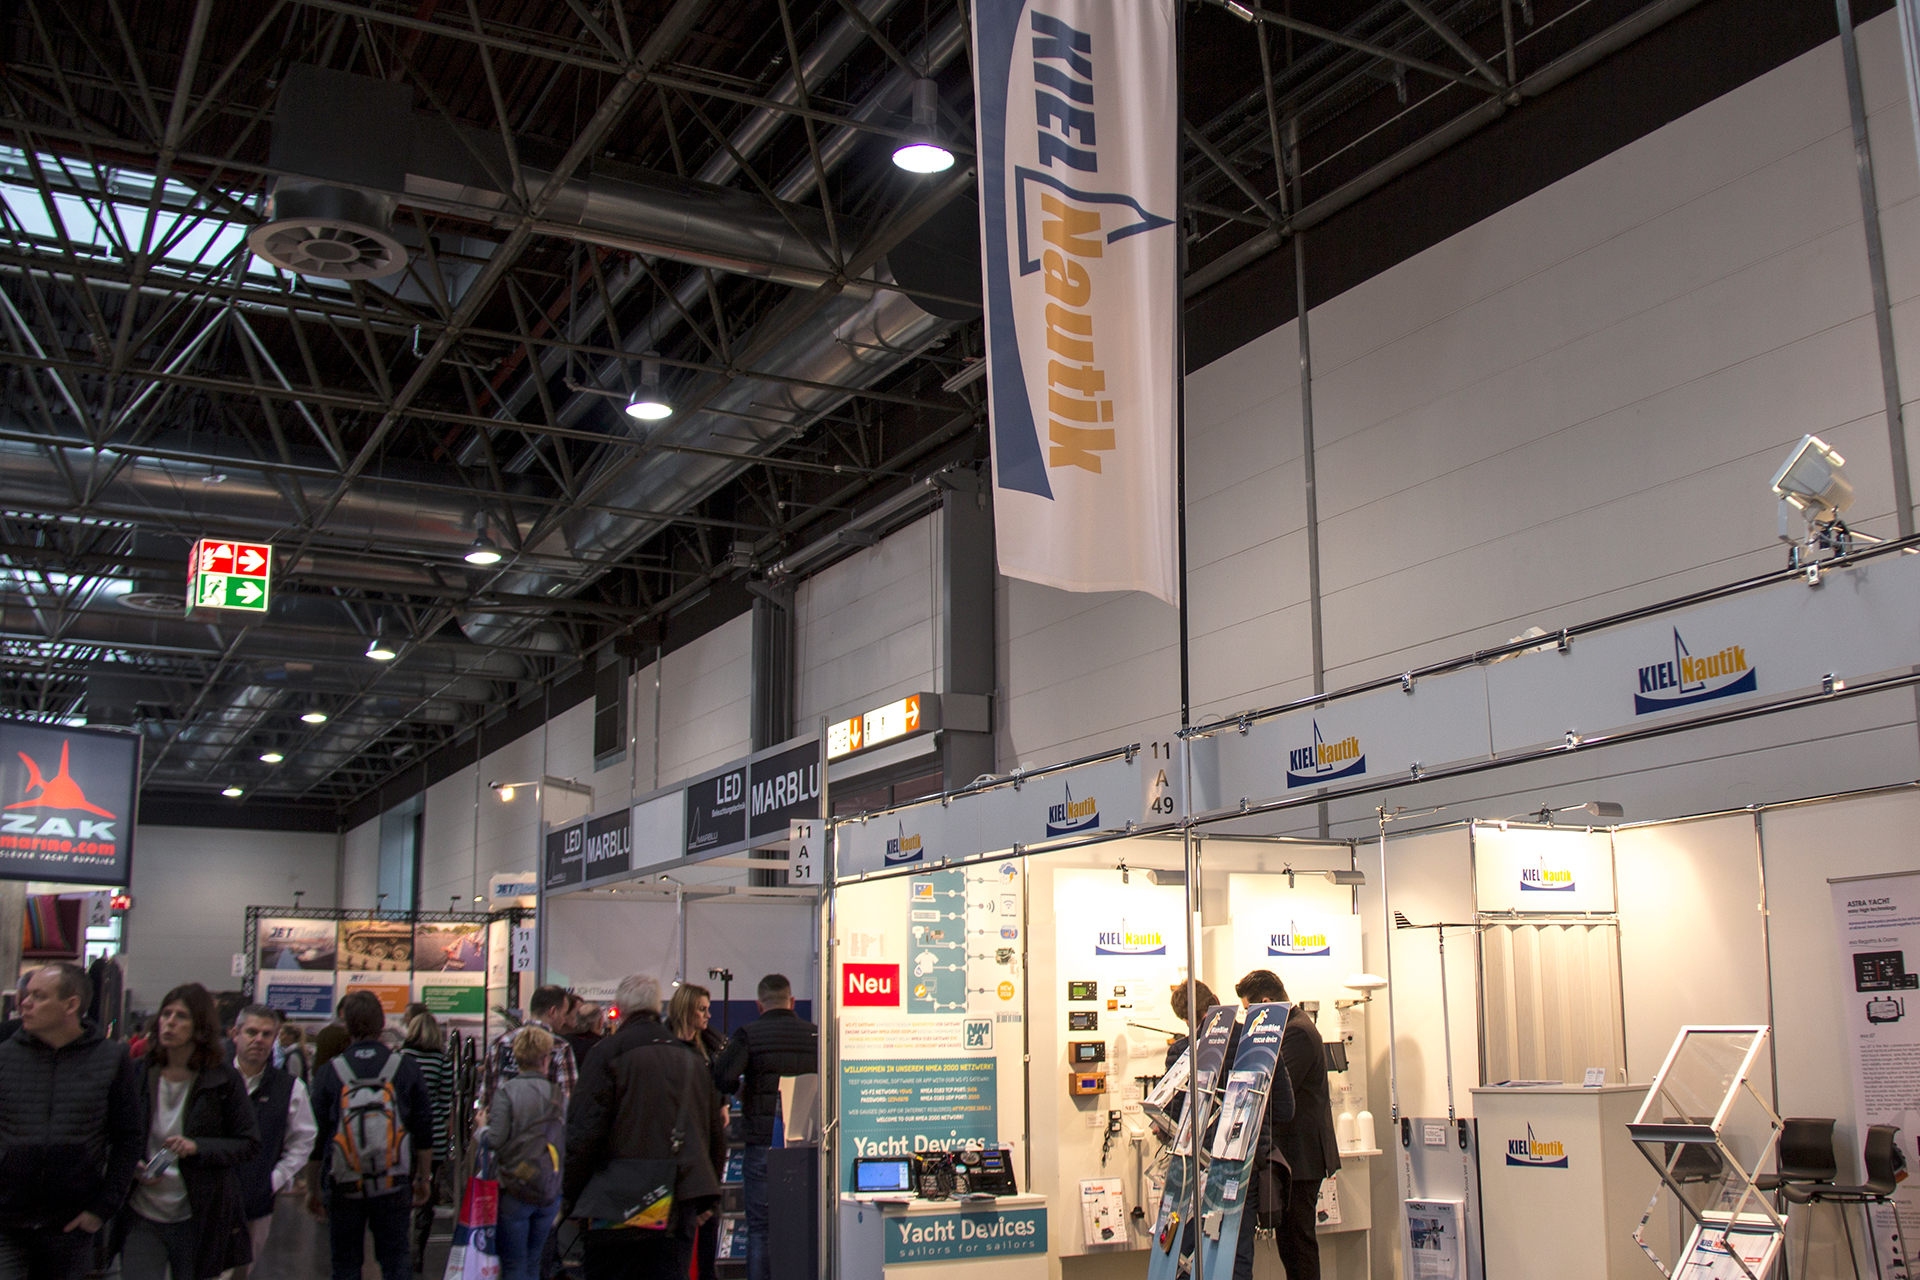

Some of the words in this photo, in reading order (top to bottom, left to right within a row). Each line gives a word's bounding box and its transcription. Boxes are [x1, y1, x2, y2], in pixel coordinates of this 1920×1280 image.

[1031, 9, 1098, 173] KIEL
[1041, 191, 1116, 475] Nautik
[1638, 661, 1678, 694] KIEL
[1681, 645, 1748, 684] Nautik
[1151, 742, 1170, 759] 11
[1290, 746, 1315, 772] KIEL
[1317, 736, 1360, 765] Nautik
[1155, 769, 1169, 787] A
[716, 773, 741, 805] LED
[751, 762, 820, 817] MARBLU
[1049, 803, 1066, 824] KIEL
[1067, 796, 1096, 819] Nautik
[1151, 796, 1174, 814] 49
[1, 813, 117, 841] ZAK
[797, 825, 811, 838] 11
[0, 835, 116, 856] marine.com
[564, 829, 581, 854] LED
[586, 826, 630, 864] MARBLU
[798, 845, 809, 858] A
[887, 838, 899, 855] KIEL
[900, 833, 921, 852] Nautik
[39, 853, 69, 862] YACHT
[72, 855, 116, 866] SUPPLIES
[795, 865, 811, 878] 51
[1522, 868, 1541, 881] KIEL
[1543, 869, 1572, 882] Nautik
[1868, 897, 1890, 905] YACHT
[518, 931, 530, 941] 11
[1099, 932, 1122, 945] KIEL
[1125, 932, 1162, 945] Nautik
[1270, 934, 1291, 946] KIEL
[1294, 933, 1327, 947] Nautik
[520, 945, 529, 954] A
[517, 958, 530, 968] 57
[848, 973, 891, 994] Neu
[967, 1023, 990, 1035] NM
[967, 1033, 984, 1046] EA
[844, 1065, 886, 1073] WILLKOMMEN
[886, 1065, 894, 1073] IN
[895, 1065, 924, 1073] UNSEREM
[925, 1064, 942, 1072] NMEA
[943, 1064, 959, 1072] 2000
[960, 1063, 994, 1071] NETZWERK!
[853, 1135, 909, 1157] Yacht
[914, 1130, 985, 1153] Devices
[1508, 1139, 1529, 1155] KIEL
[1530, 1140, 1564, 1156] Nautik
[898, 1220, 956, 1244] Yacht
[961, 1216, 1036, 1240] Devices
[899, 1245, 951, 1257] sailors
[958, 1243, 979, 1253] for
[986, 1240, 1035, 1251] sailors
